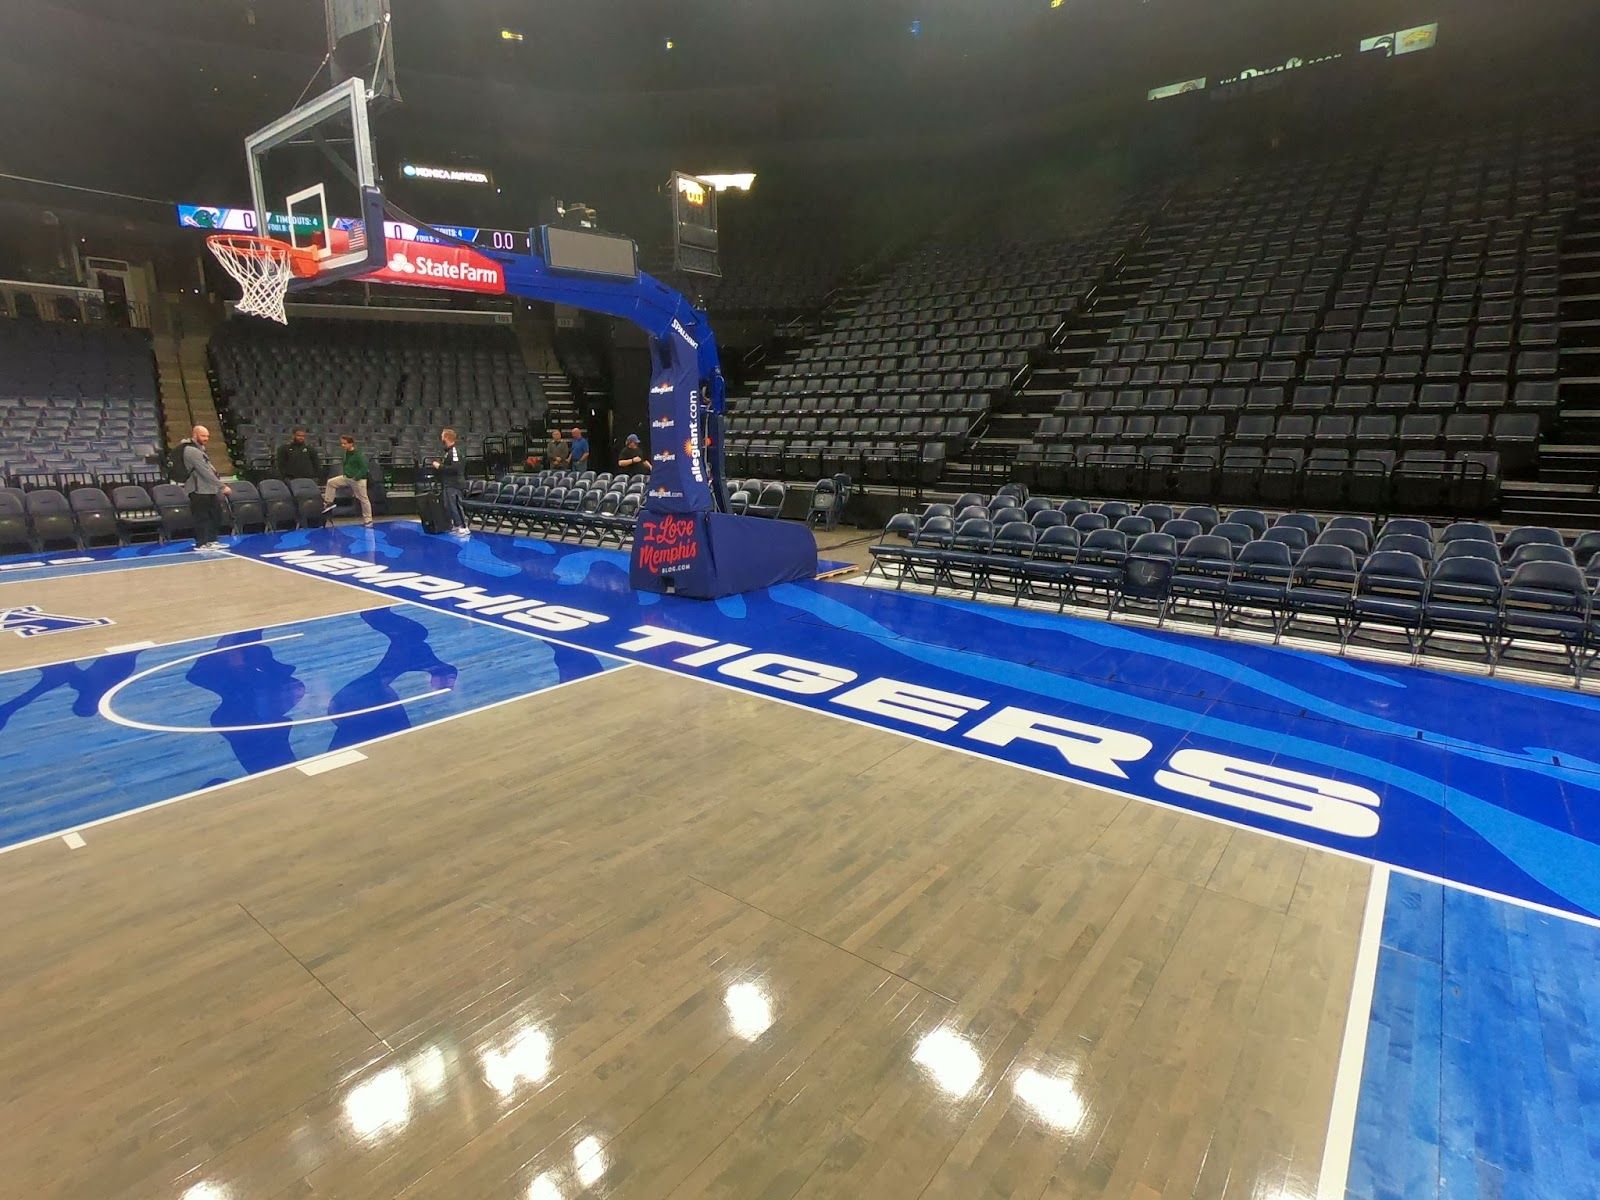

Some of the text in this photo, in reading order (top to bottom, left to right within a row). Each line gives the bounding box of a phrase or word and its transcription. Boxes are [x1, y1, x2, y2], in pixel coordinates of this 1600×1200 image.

[275, 215, 318, 226] TIMOUTS: 4
[493, 232, 513, 249] 0.0
[689, 390, 703, 483] allegiant.com
[643, 514, 694, 545] I Love
[639, 540, 697, 574] Memphis
[661, 564, 691, 574] BLOG.COM
[259, 549, 1381, 838] MEMPHIS TIGERS
